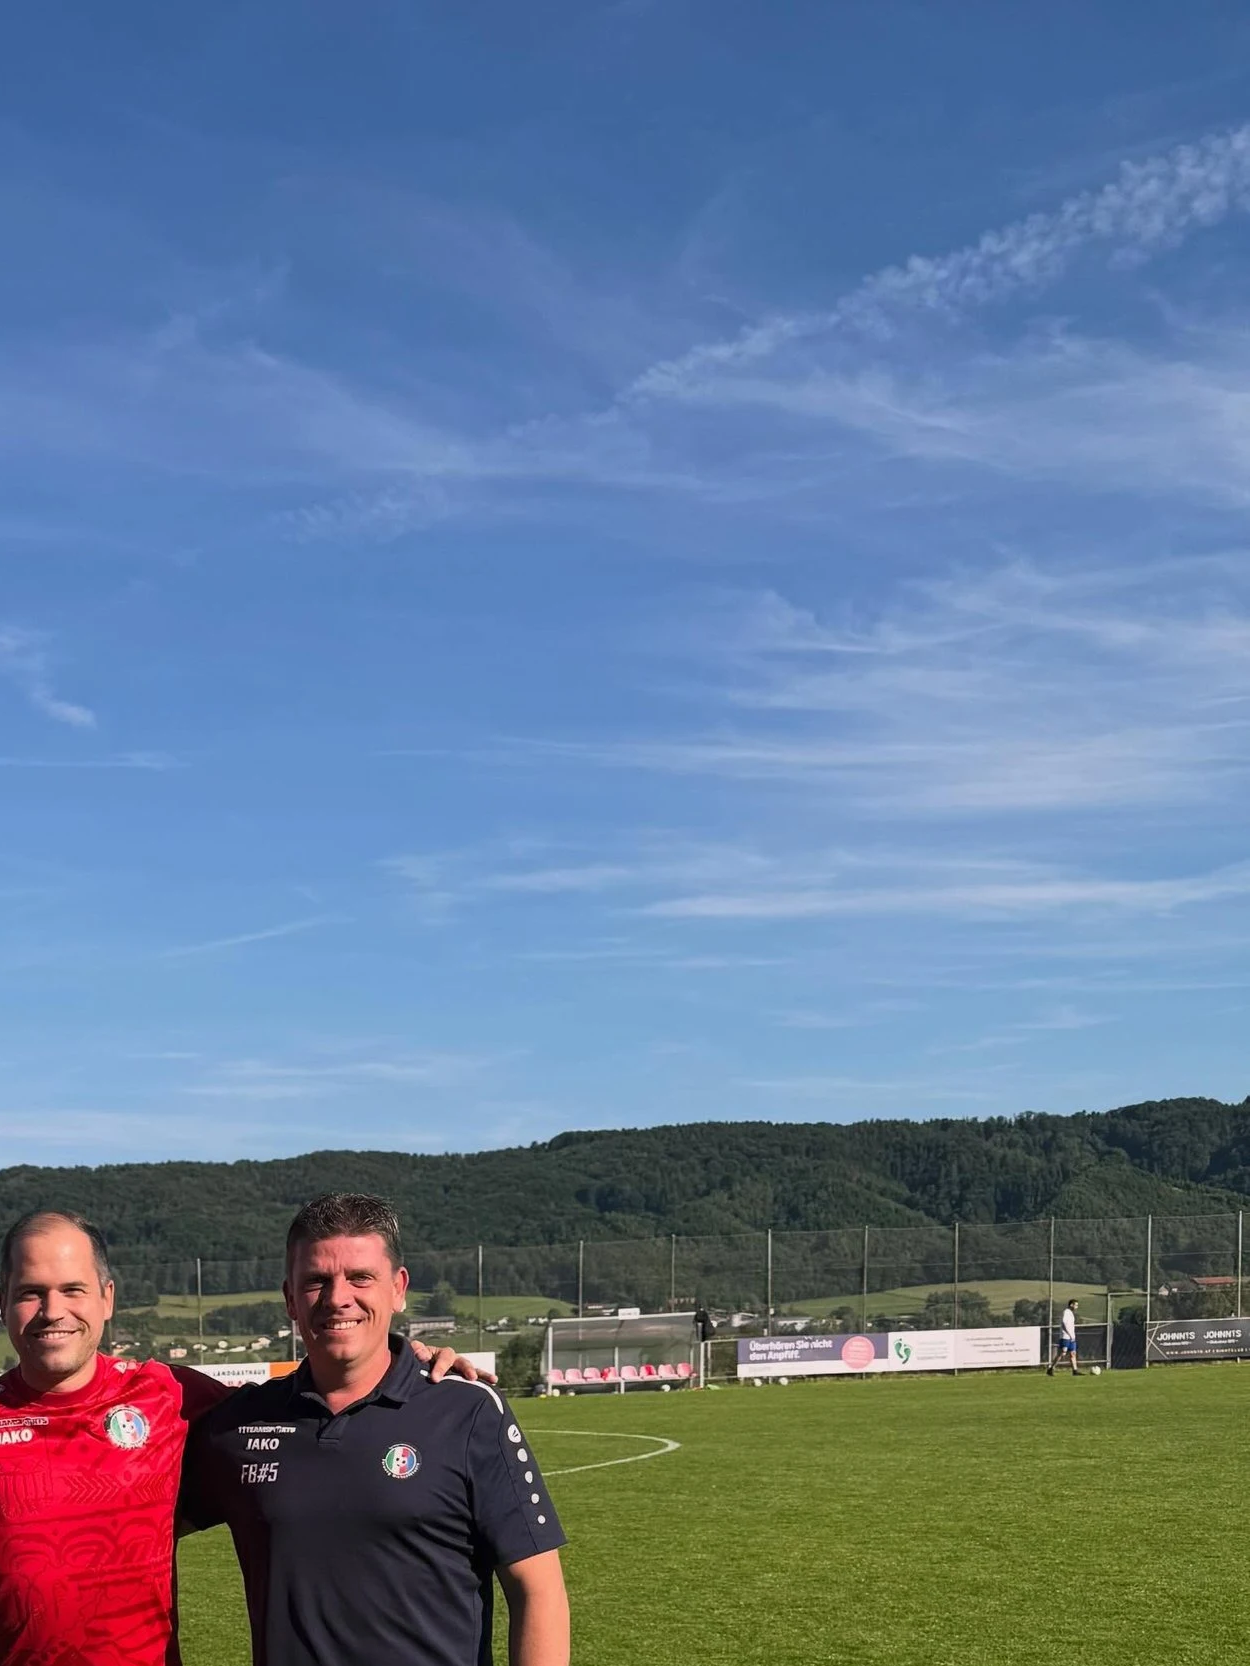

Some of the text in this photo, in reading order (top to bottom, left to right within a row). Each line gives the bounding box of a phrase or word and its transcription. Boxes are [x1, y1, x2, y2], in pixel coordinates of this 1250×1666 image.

[749, 1338, 833, 1351] Überhören Sie nicht
[749, 1352, 766, 1361] den
[246, 1438, 280, 1450] JAKO
[241, 1462, 280, 1484] FB#5
